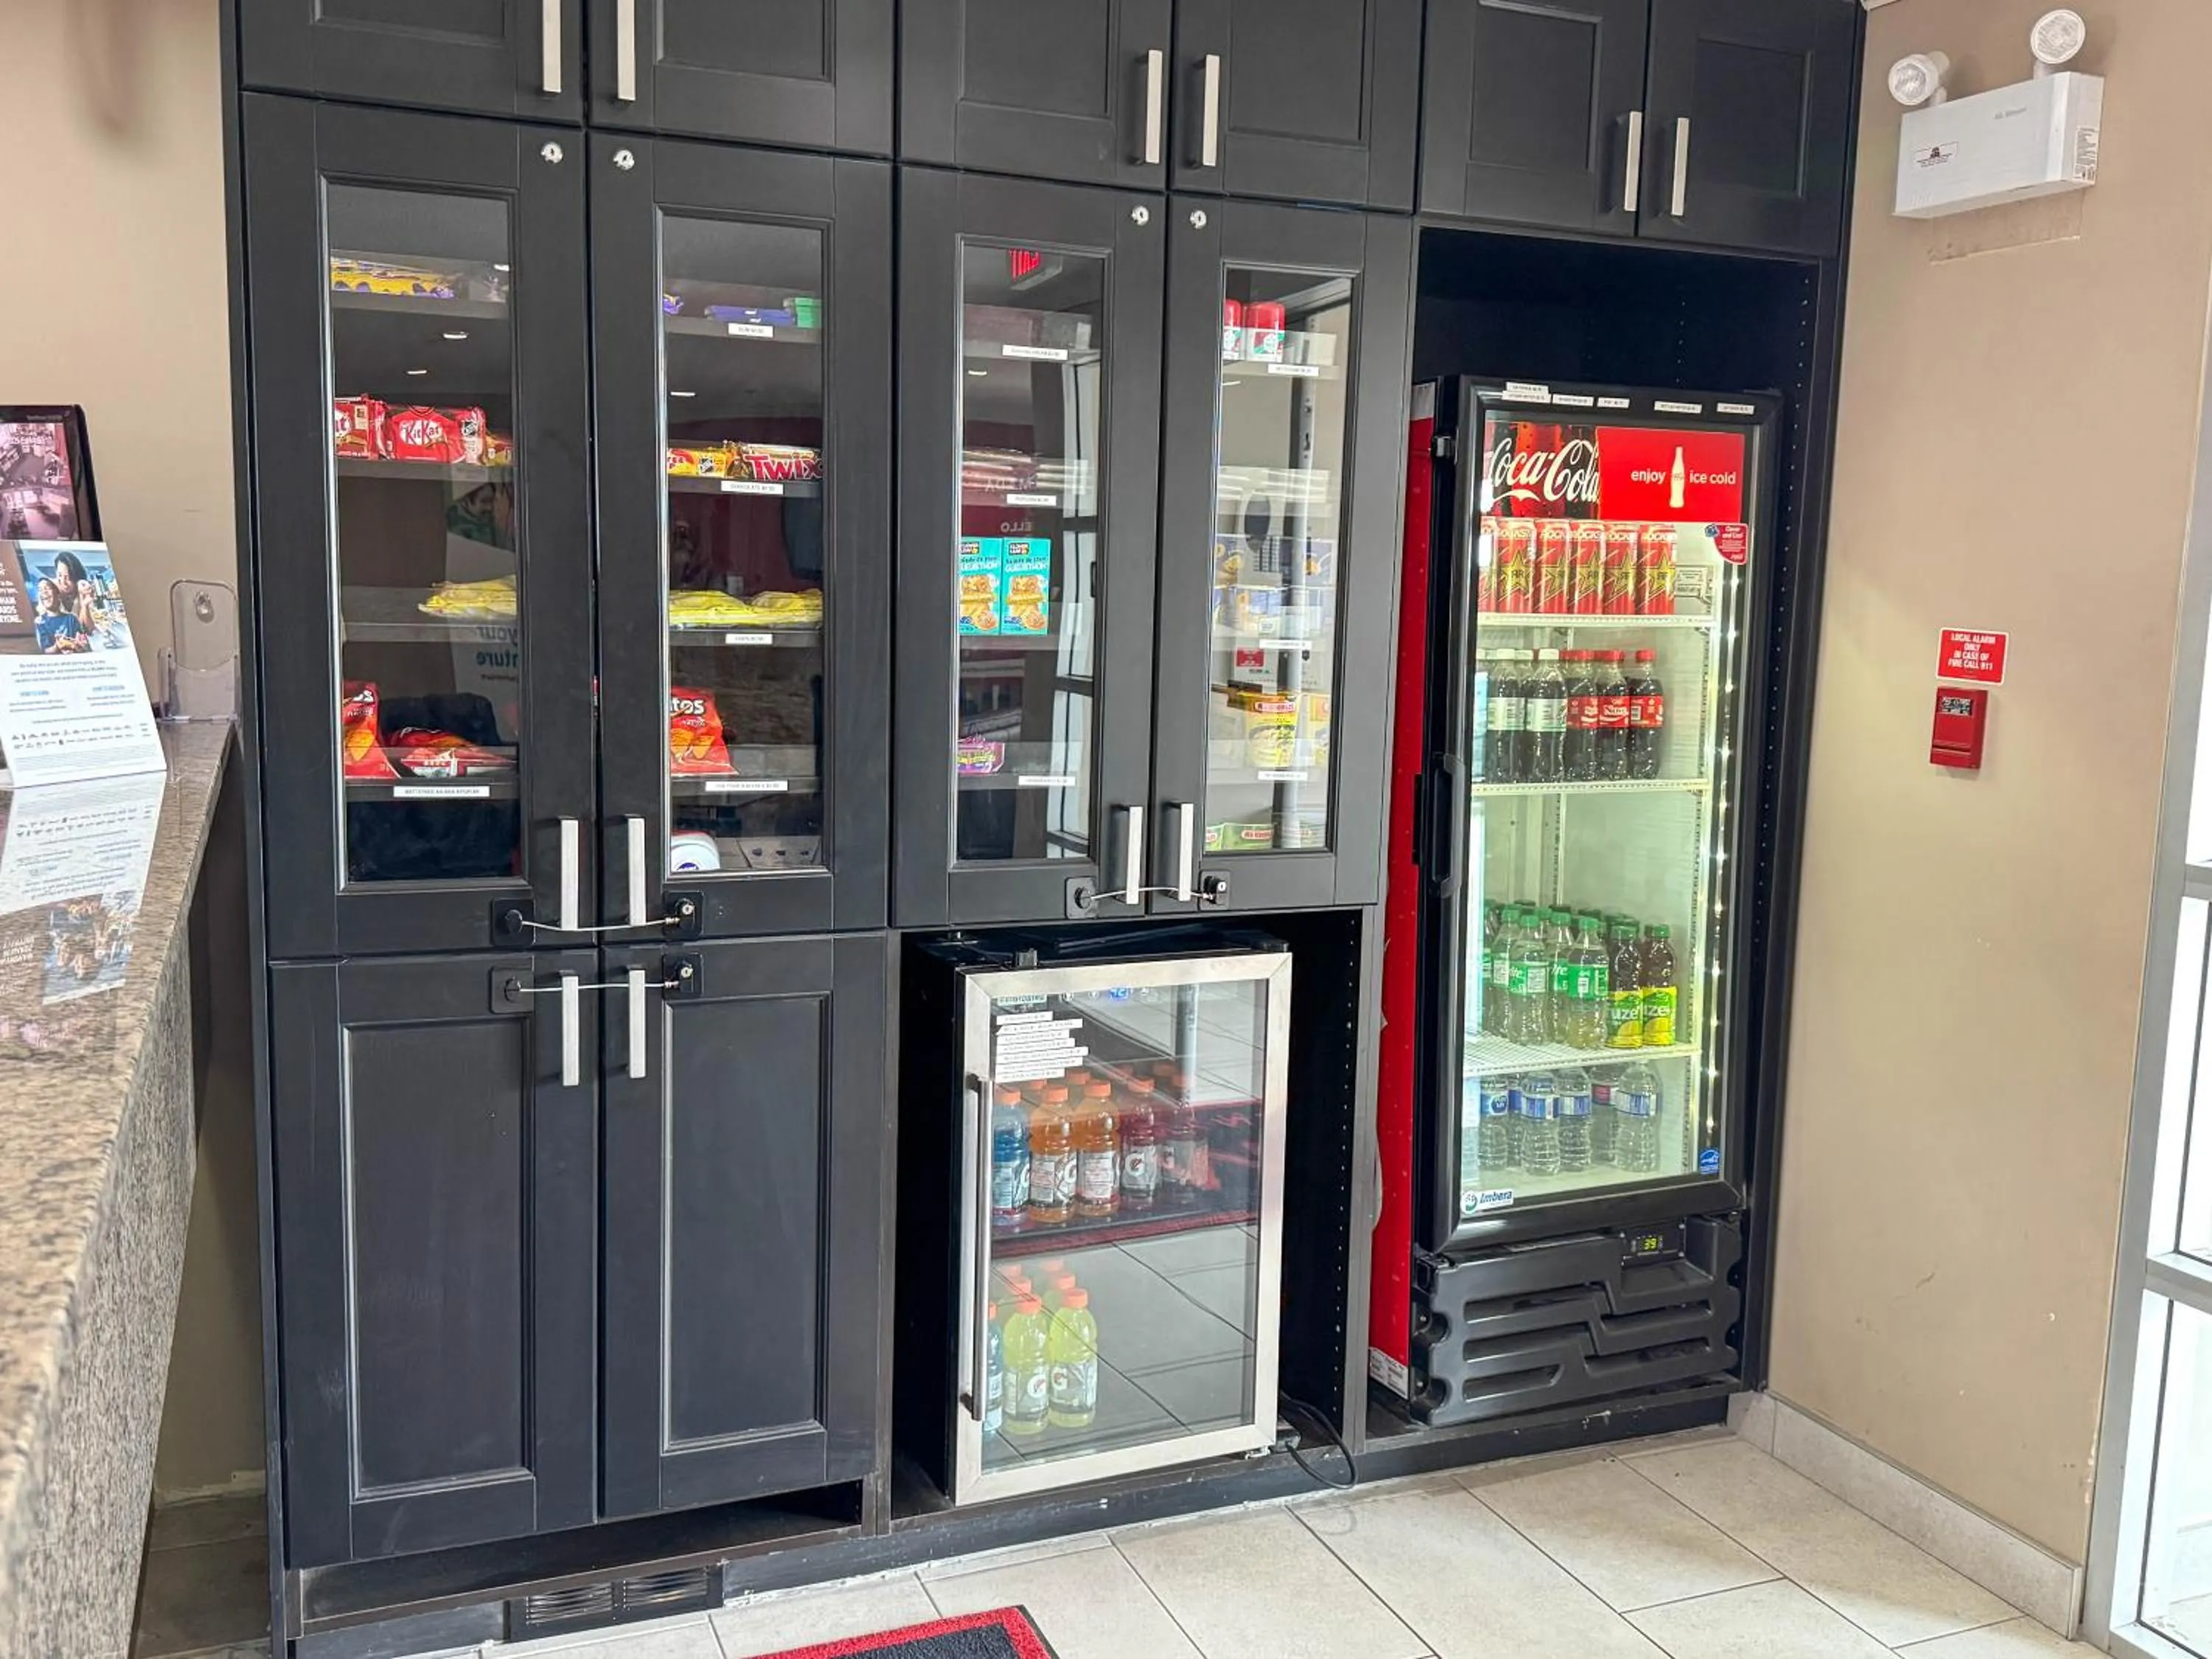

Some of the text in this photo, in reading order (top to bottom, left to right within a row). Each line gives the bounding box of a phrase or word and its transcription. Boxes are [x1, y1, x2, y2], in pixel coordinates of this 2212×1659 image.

[1488, 437, 1600, 502] Coca-Cola
[1630, 467, 1737, 484] enjoy ice cold
[1972, 634, 1996, 644] ALARM
[1962, 651, 1979, 660] CASE
[1964, 660, 1980, 669] CALL
